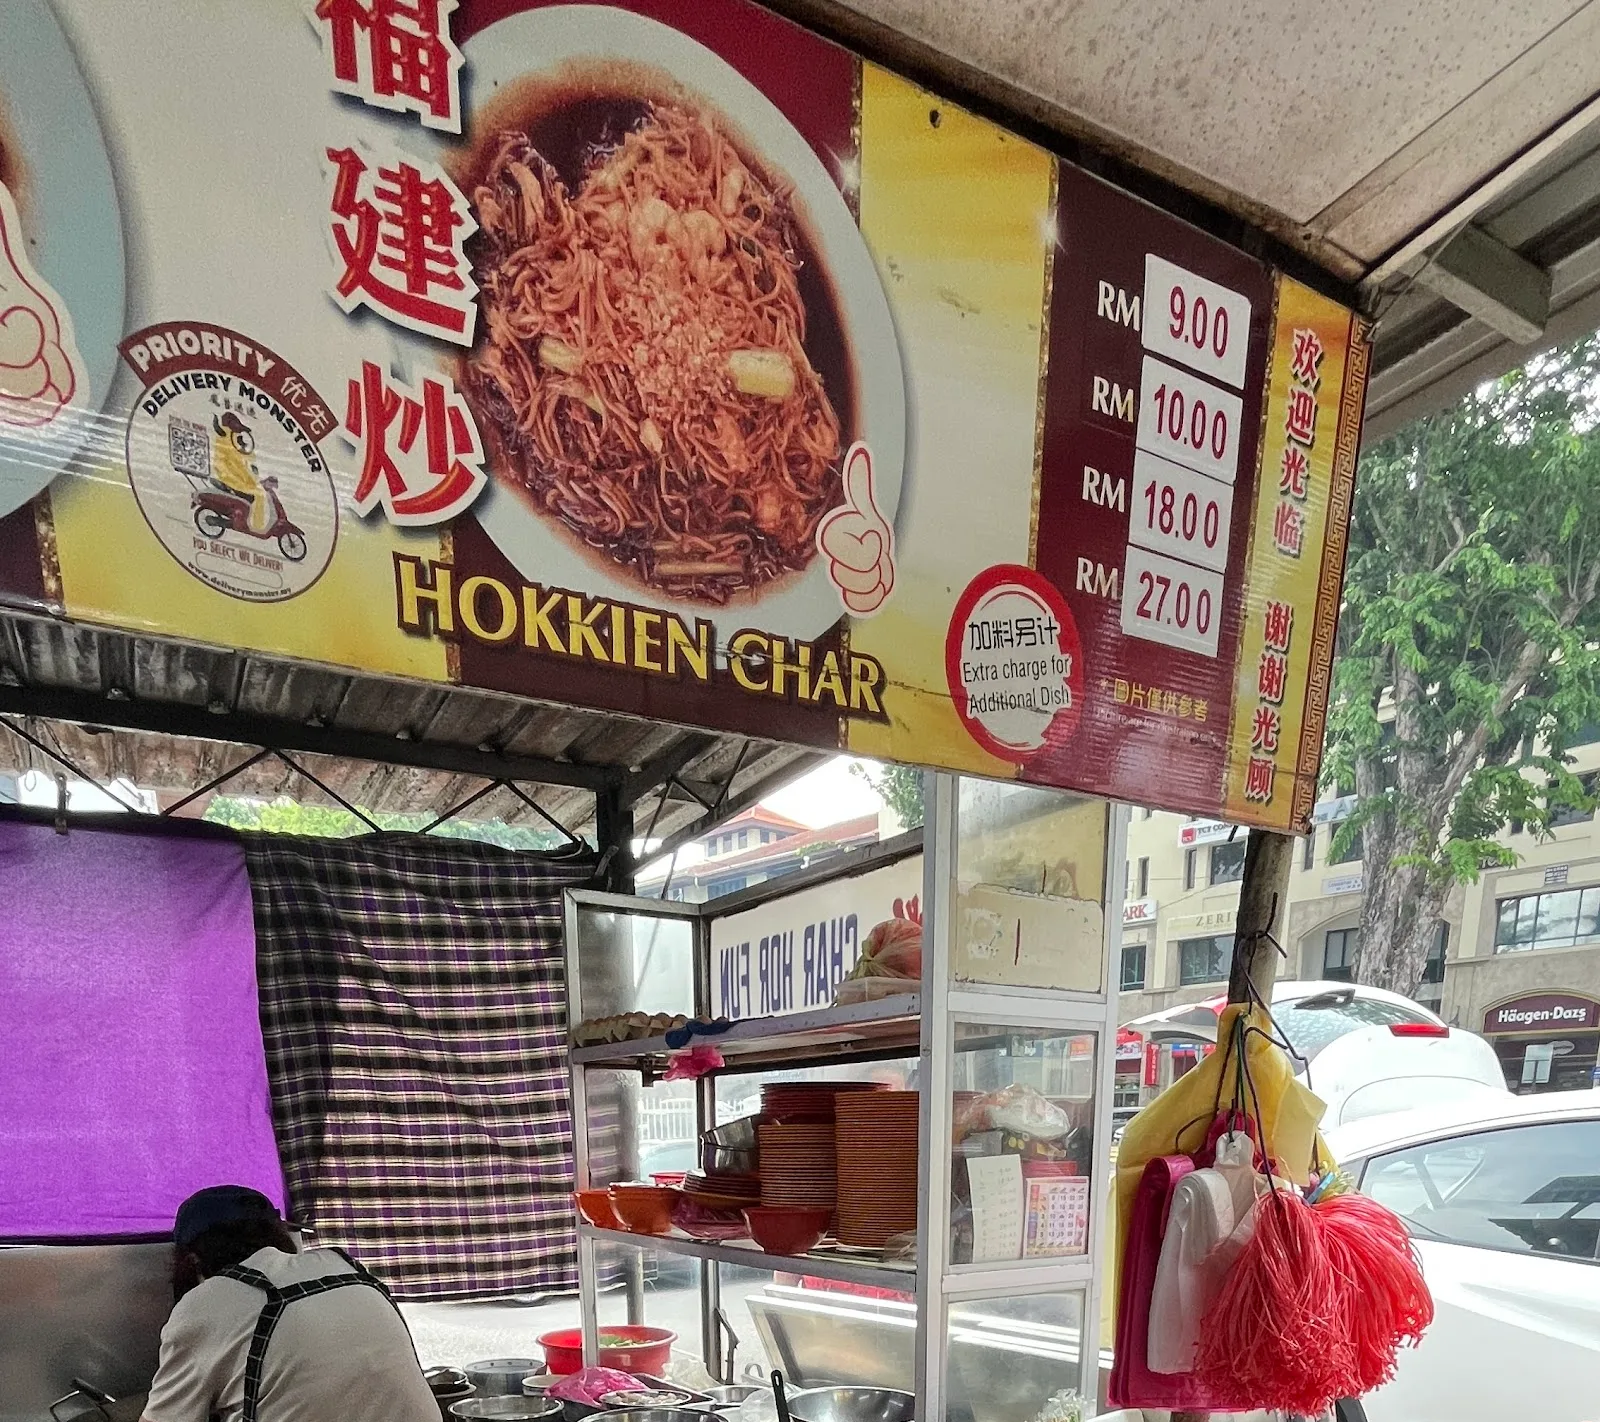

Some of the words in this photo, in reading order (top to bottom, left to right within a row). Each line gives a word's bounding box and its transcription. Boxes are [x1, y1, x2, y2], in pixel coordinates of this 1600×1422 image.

[128, 328, 276, 379] PRIORITY
[1097, 279, 1141, 332] RM
[1168, 285, 1229, 359] 9.00
[141, 372, 232, 419] DELIVERY
[238, 381, 323, 474] MONSTER
[279, 375, 331, 437] 优先
[1091, 375, 1135, 424] RM
[1154, 383, 1228, 460] 10.00
[1272, 330, 1322, 552] 欢迎光临
[1081, 464, 1126, 513] RM
[1144, 479, 1220, 549] 18.00
[397, 557, 709, 681] HOKKIEN
[728, 631, 885, 714] CHAR
[968, 616, 1058, 652] 加料另计
[1075, 556, 1119, 601] RM
[1135, 570, 1212, 635] 27.00
[963, 661, 999, 684] Extra
[1002, 658, 1048, 682] charge
[1050, 655, 1070, 675] for
[969, 688, 1037, 715] Additional
[1040, 685, 1070, 706] Dish
[1246, 600, 1291, 798] 谢谢光顾
